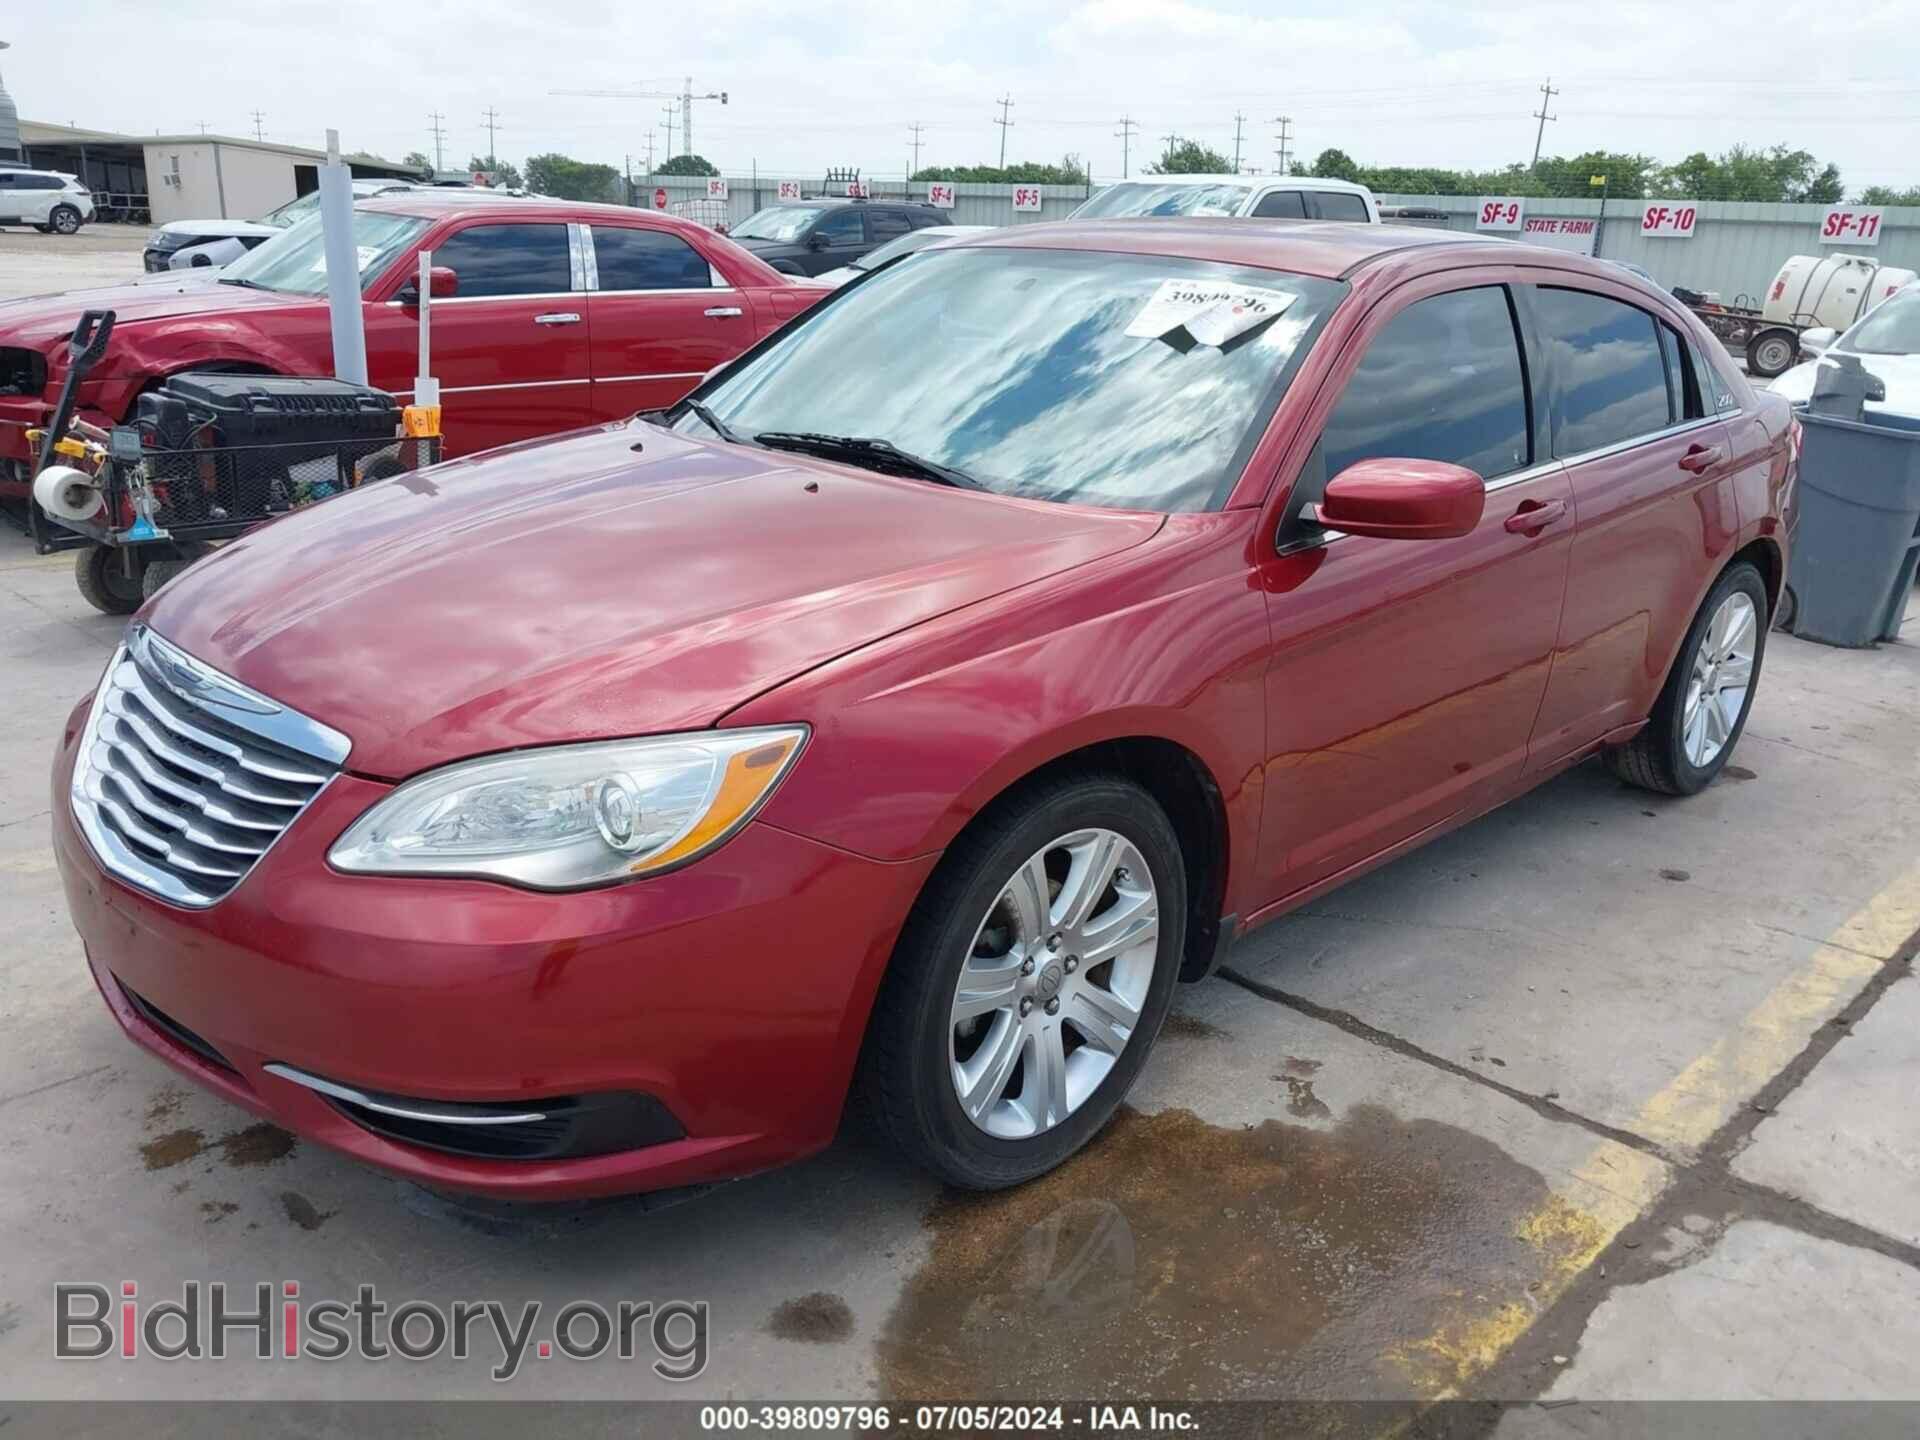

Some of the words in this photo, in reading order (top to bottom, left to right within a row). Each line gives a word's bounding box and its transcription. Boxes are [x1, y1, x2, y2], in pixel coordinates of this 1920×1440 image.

[780, 183, 799, 197] SF-2
[930, 186, 953, 203] SF-4
[1015, 188, 1039, 206] SF-5
[1481, 202, 1519, 225] SF-9
[1643, 207, 1696, 230] SF-10
[1525, 219, 1558, 233] STATE
[1560, 220, 1594, 235] FARM
[1823, 212, 1880, 238] SF-11
